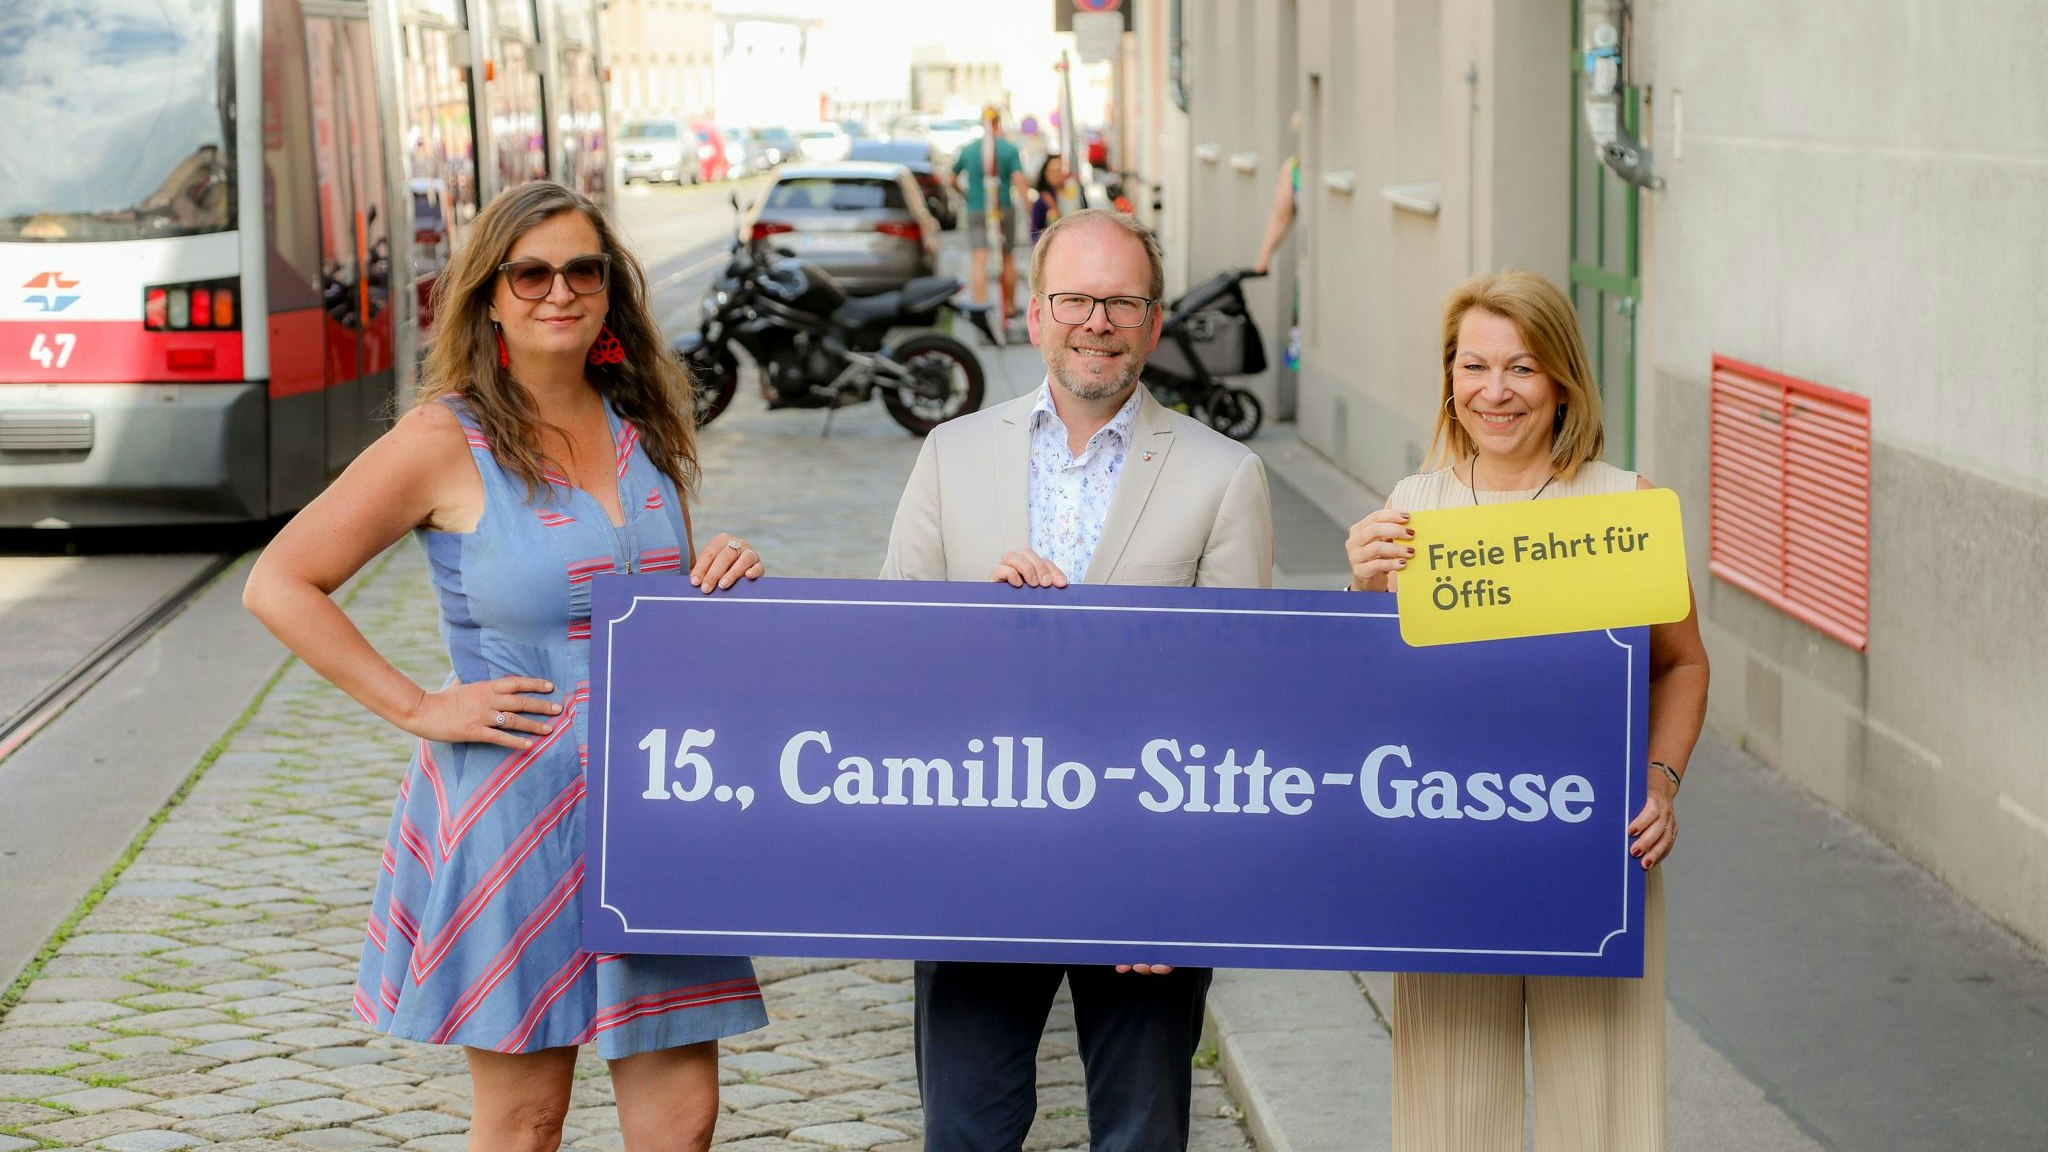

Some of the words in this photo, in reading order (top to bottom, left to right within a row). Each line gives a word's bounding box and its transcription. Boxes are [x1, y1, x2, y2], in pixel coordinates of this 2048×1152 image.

[28, 332, 77, 369] 47
[1427, 538, 1506, 572] Freie
[1512, 531, 1598, 564] Fahrt
[1601, 525, 1650, 555] für
[1431, 575, 1513, 612] Öffis
[638, 728, 755, 812] 15.,
[779, 730, 1596, 824] Camillo-Sitte-Gasse
